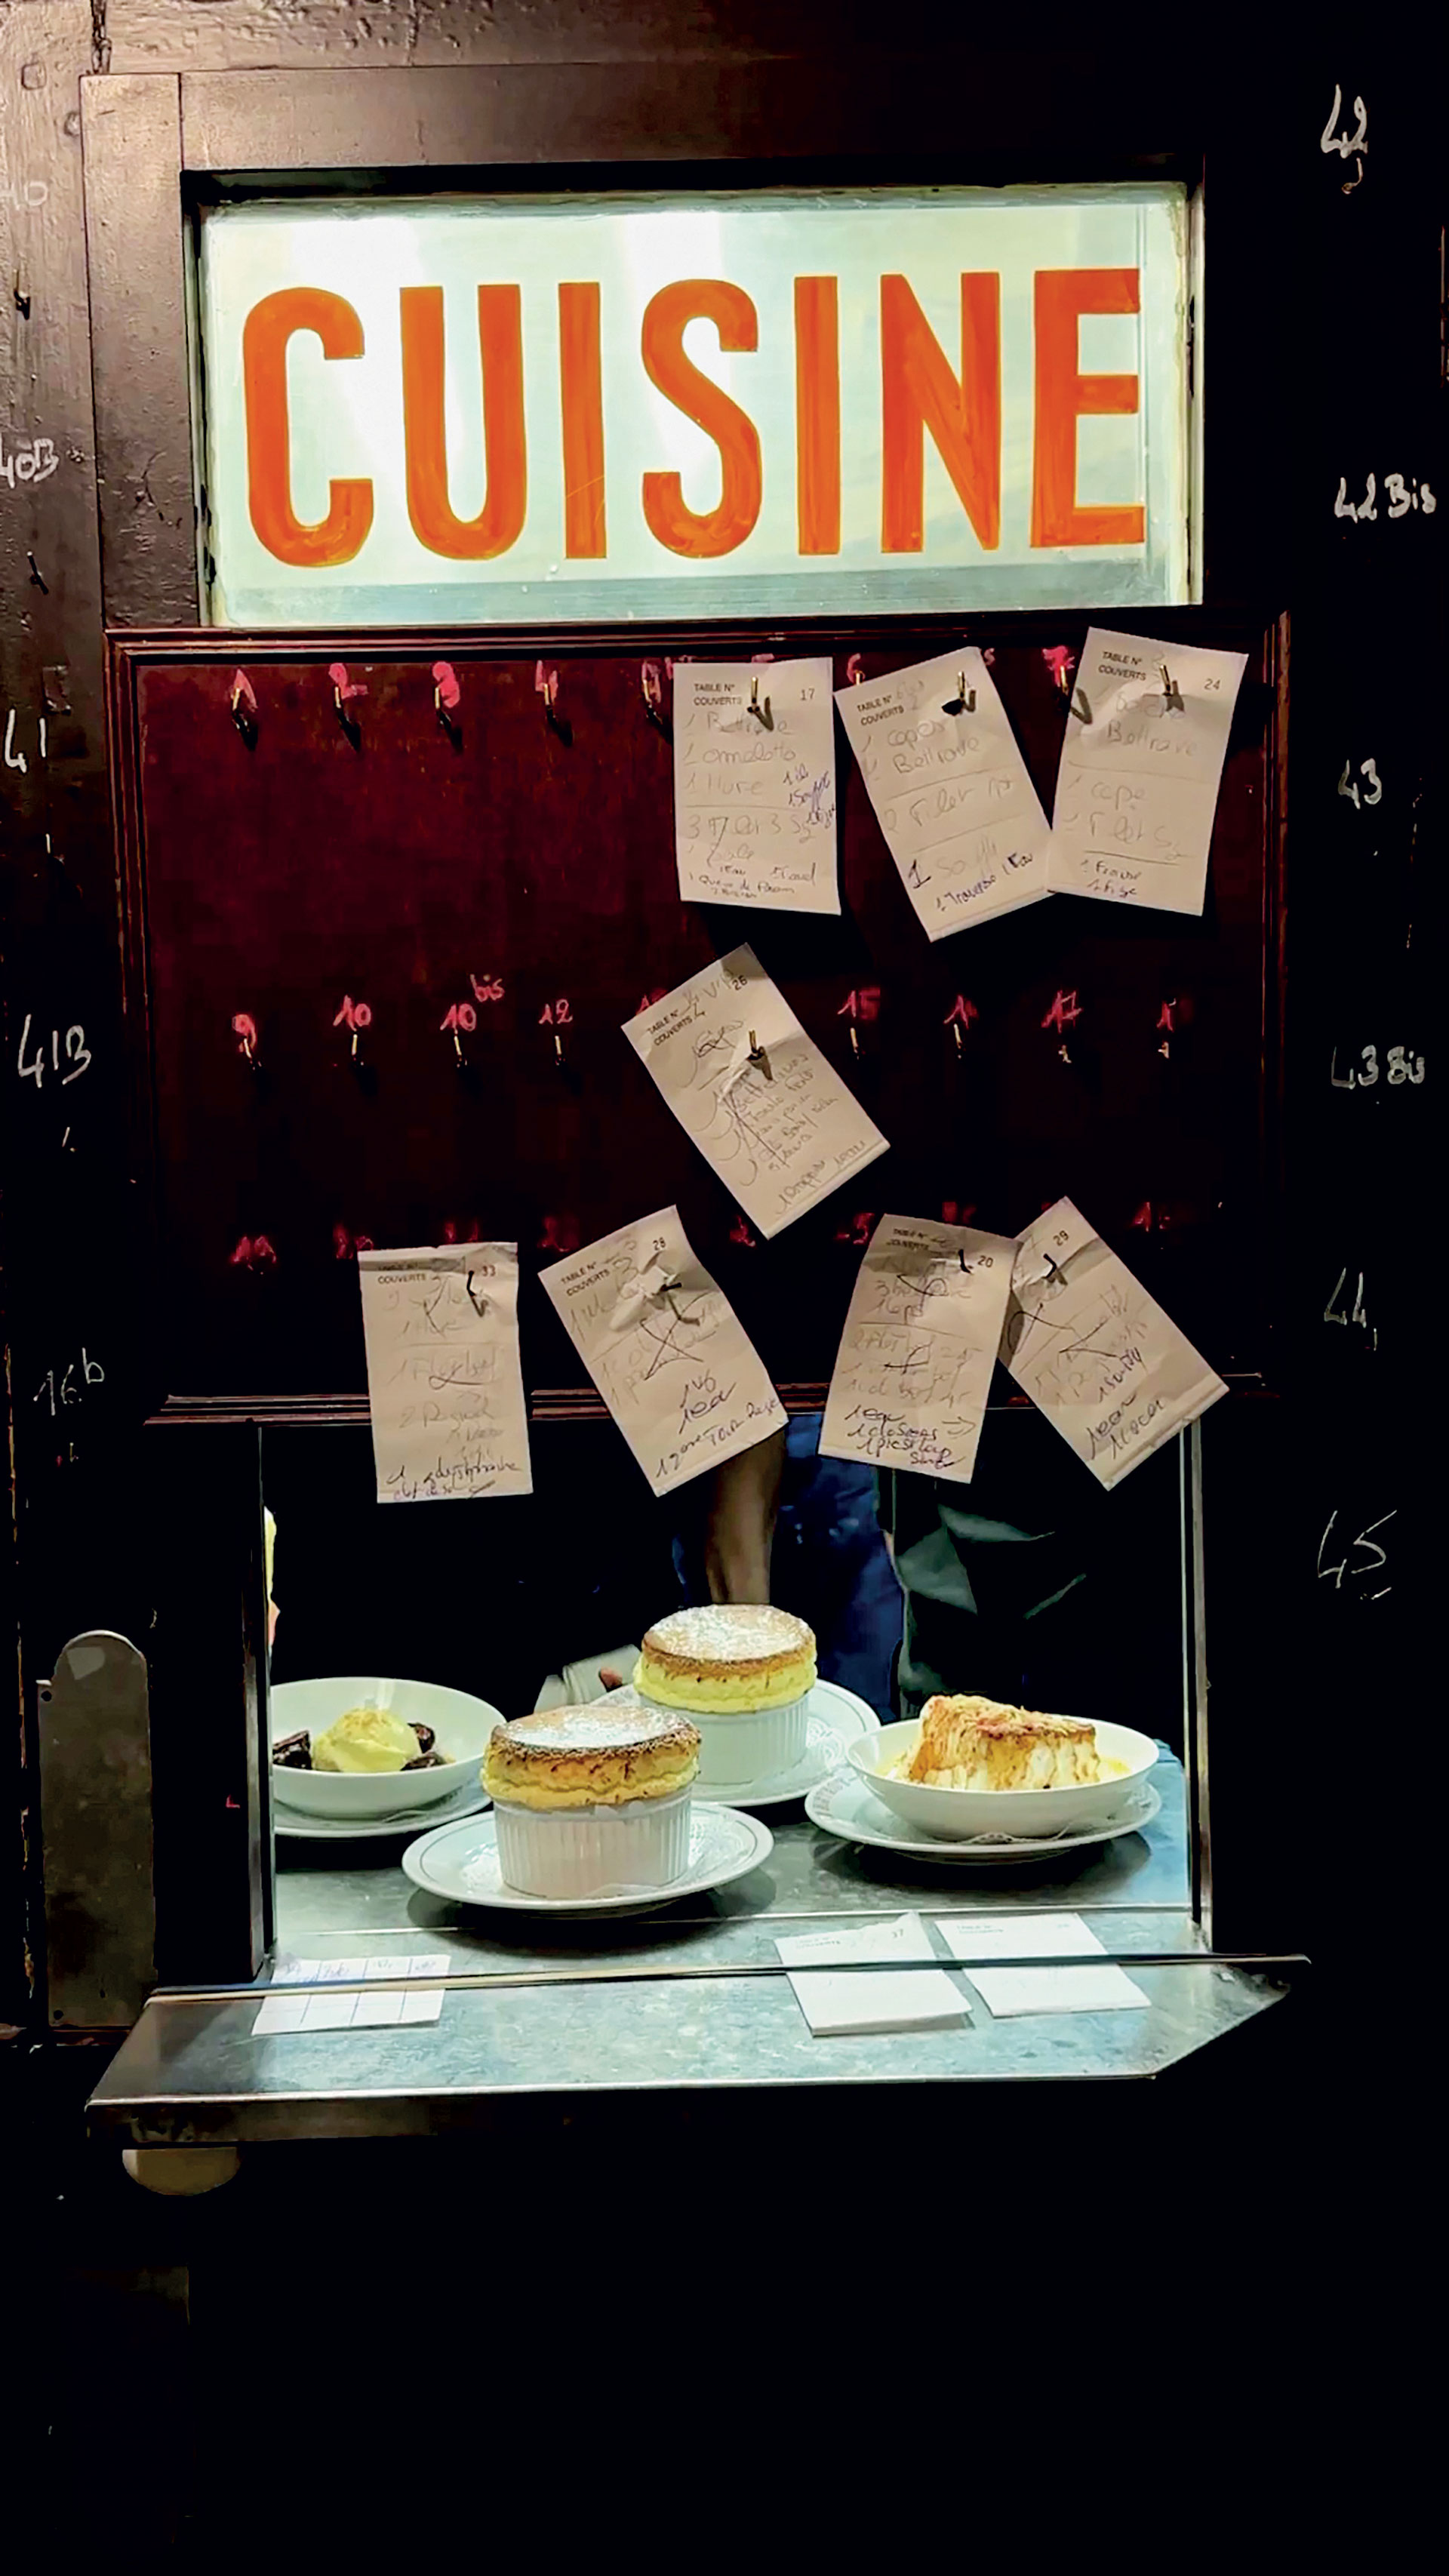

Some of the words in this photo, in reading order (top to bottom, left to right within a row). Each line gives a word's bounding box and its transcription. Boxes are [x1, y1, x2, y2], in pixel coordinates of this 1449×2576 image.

[1321, 84, 1369, 158] 42
[242, 268, 1145, 568] CUISINE
[1102, 651, 1130, 666] TABLE
[1098, 664, 1146, 682] COUVERTS
[432, 661, 460, 708] 3
[694, 683, 721, 693] TABLE
[1204, 679, 1221, 691] 24
[801, 688, 816, 701] 17
[857, 699, 881, 712] TABLE
[860, 704, 905, 726] COUVERTS
[5, 709, 46, 773] 41
[1338, 758, 1383, 810] 43
[732, 974, 749, 991] 26
[333, 994, 371, 1032] 10
[539, 999, 573, 1025] 12
[654, 1015, 693, 1046] COUVERTS
[653, 1236, 666, 1251] 28
[1053, 1230, 1069, 1247] 29
[977, 1254, 994, 1268] 20
[481, 1266, 496, 1277] 33
[561, 1266, 586, 1284] TABLE
[566, 1269, 611, 1297] COUVERTS
[1317, 1510, 1398, 1589] 45
